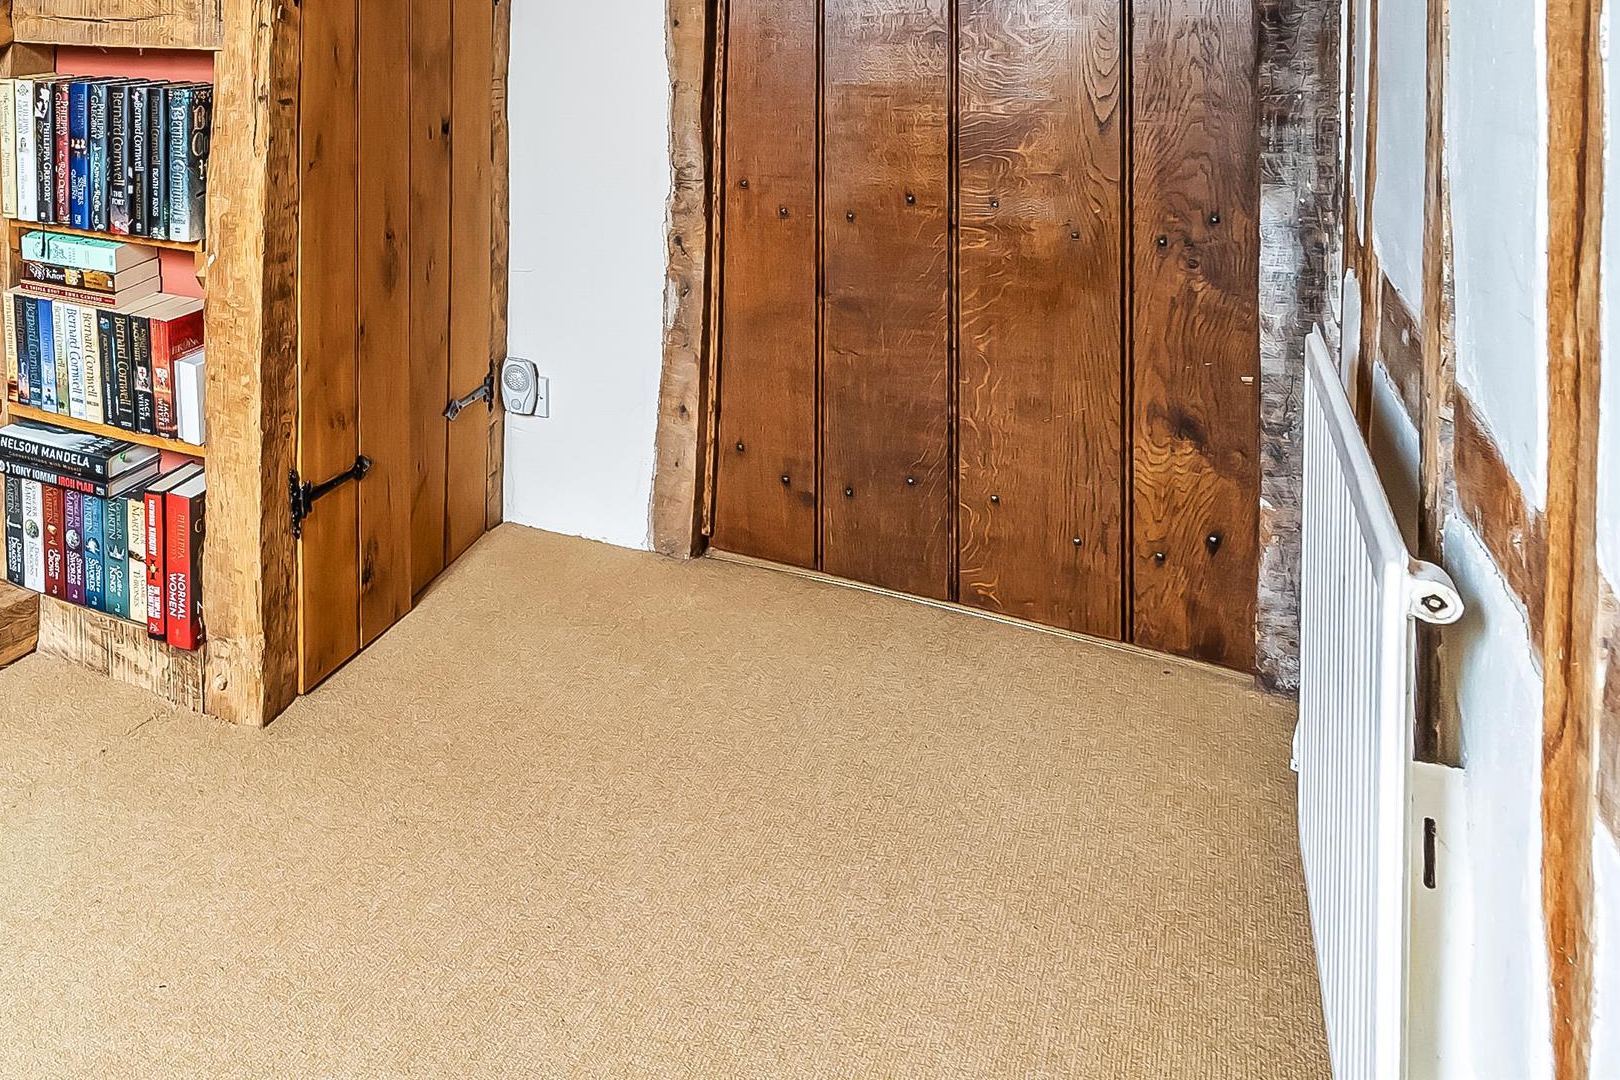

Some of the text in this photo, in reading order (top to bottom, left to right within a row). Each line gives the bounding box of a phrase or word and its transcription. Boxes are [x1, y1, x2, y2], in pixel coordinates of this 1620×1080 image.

[112, 92, 125, 186] Bernard Cornwell
[67, 308, 83, 401] Bernard Cornwell
[0, 436, 90, 469] NELSON MANDELA
[10, 463, 94, 493] TONY IOMMI IRON MAN
[169, 572, 177, 617] WOMEN
[177, 572, 187, 620] NORMAL
